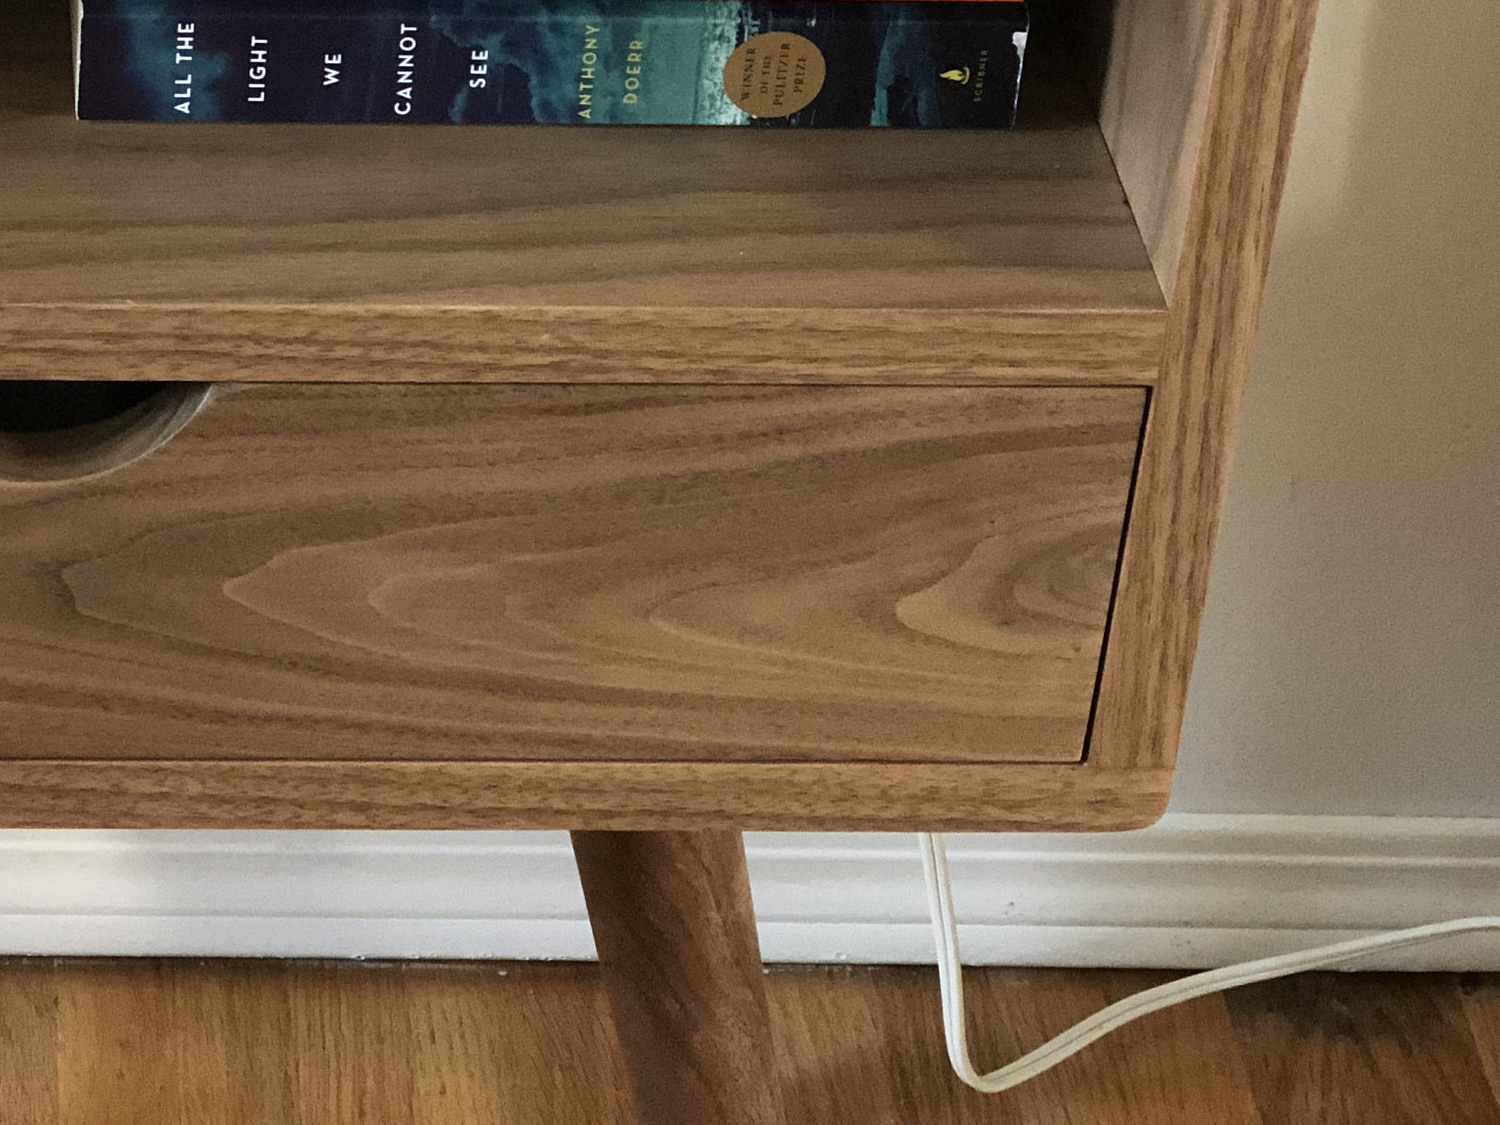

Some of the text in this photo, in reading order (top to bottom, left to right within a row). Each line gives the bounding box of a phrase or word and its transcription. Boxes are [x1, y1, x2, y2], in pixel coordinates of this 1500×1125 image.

[174, 23, 195, 114] ALL THE
[247, 36, 268, 102] LIGHT
[323, 53, 342, 86] WE
[394, 23, 417, 115] CANNOT
[469, 50, 489, 88] SEE
[578, 24, 600, 119] ANTHONY
[623, 40, 644, 104] DOERR
[741, 47, 756, 101] WINNER
[760, 55, 772, 94] OF THE
[773, 43, 791, 106] PULITZER
[792, 56, 807, 93] PRIZE
[973, 50, 988, 103] SCRIBNER
